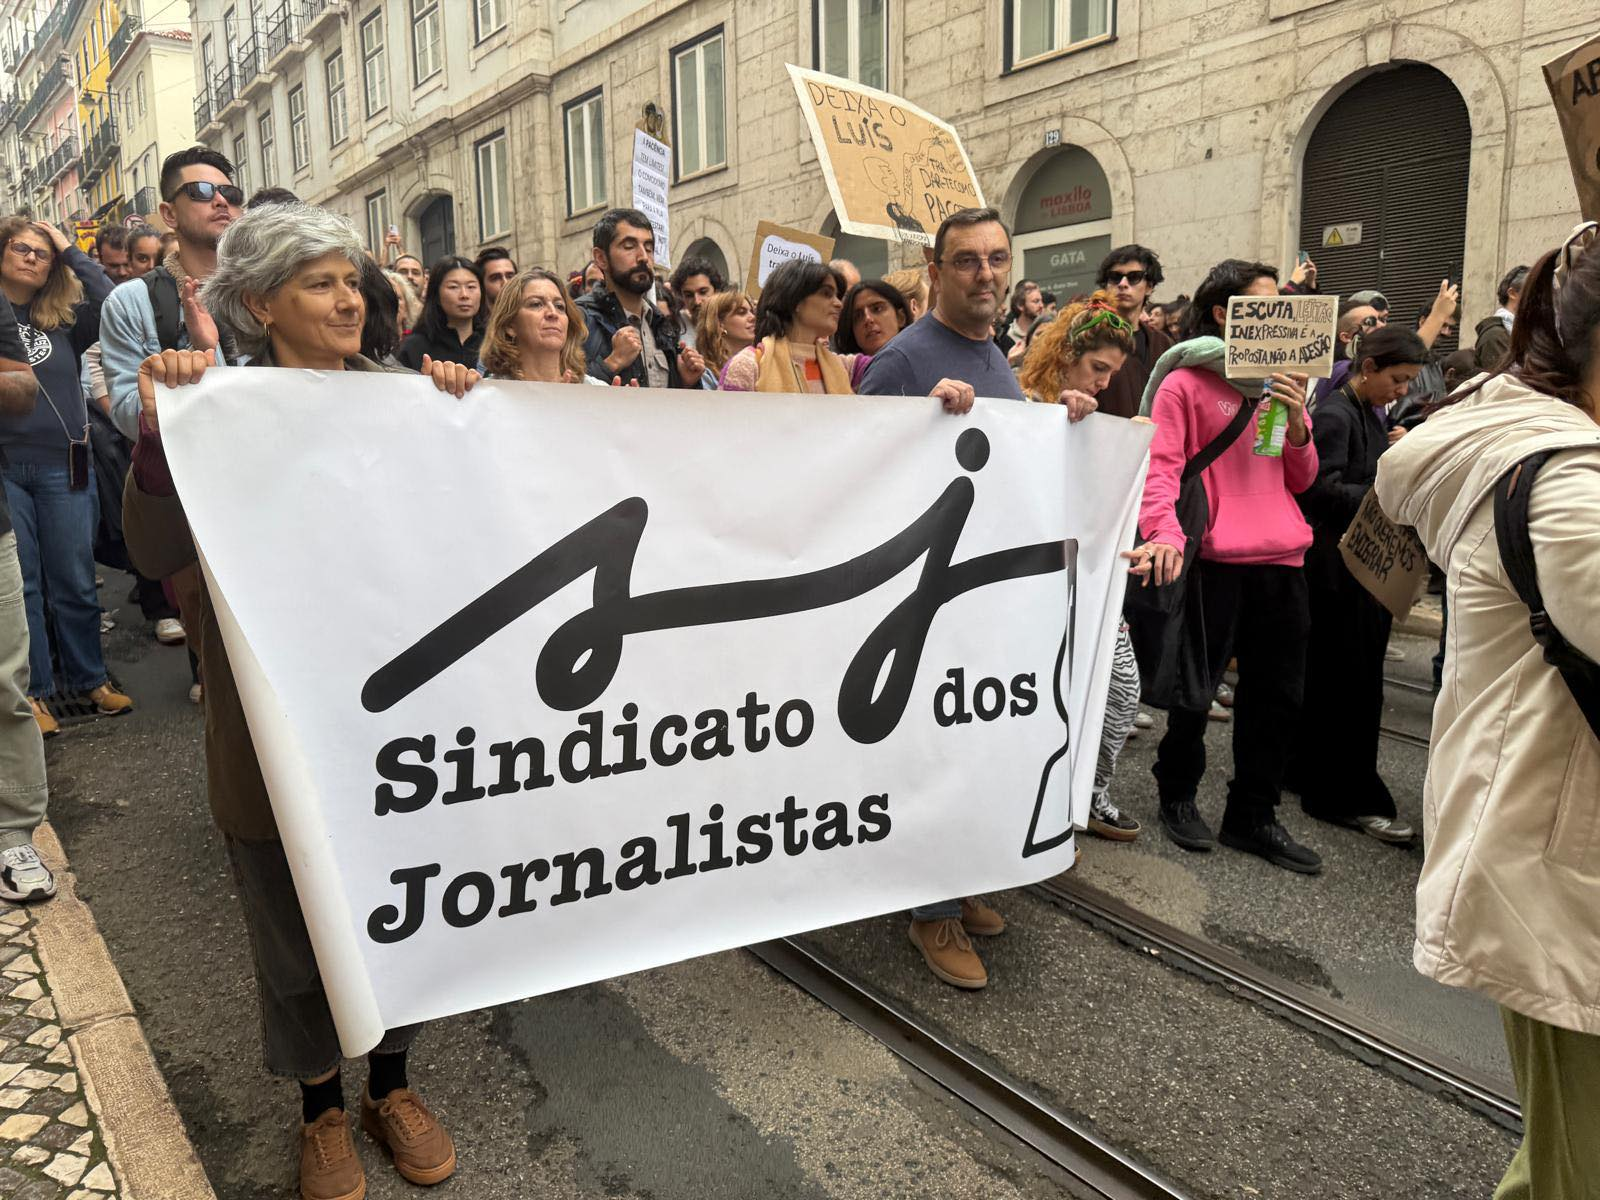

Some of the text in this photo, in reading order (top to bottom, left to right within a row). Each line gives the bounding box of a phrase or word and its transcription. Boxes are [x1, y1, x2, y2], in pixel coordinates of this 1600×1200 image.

[808, 82, 906, 126] DEIXA O
[832, 115, 893, 152] LUÍS
[1046, 131, 1059, 145] 129
[767, 244, 789, 257] Deixa
[1051, 251, 1085, 267] GATA
[1231, 301, 1295, 322] ESCUTA,
[1230, 324, 1315, 340] INEXPRESSIVA É A
[1289, 350, 1296, 361] A
[1299, 333, 1331, 364] ADESÃO
[374, 667, 1038, 817] Sindicato dos
[367, 793, 892, 944] Jornalistas
